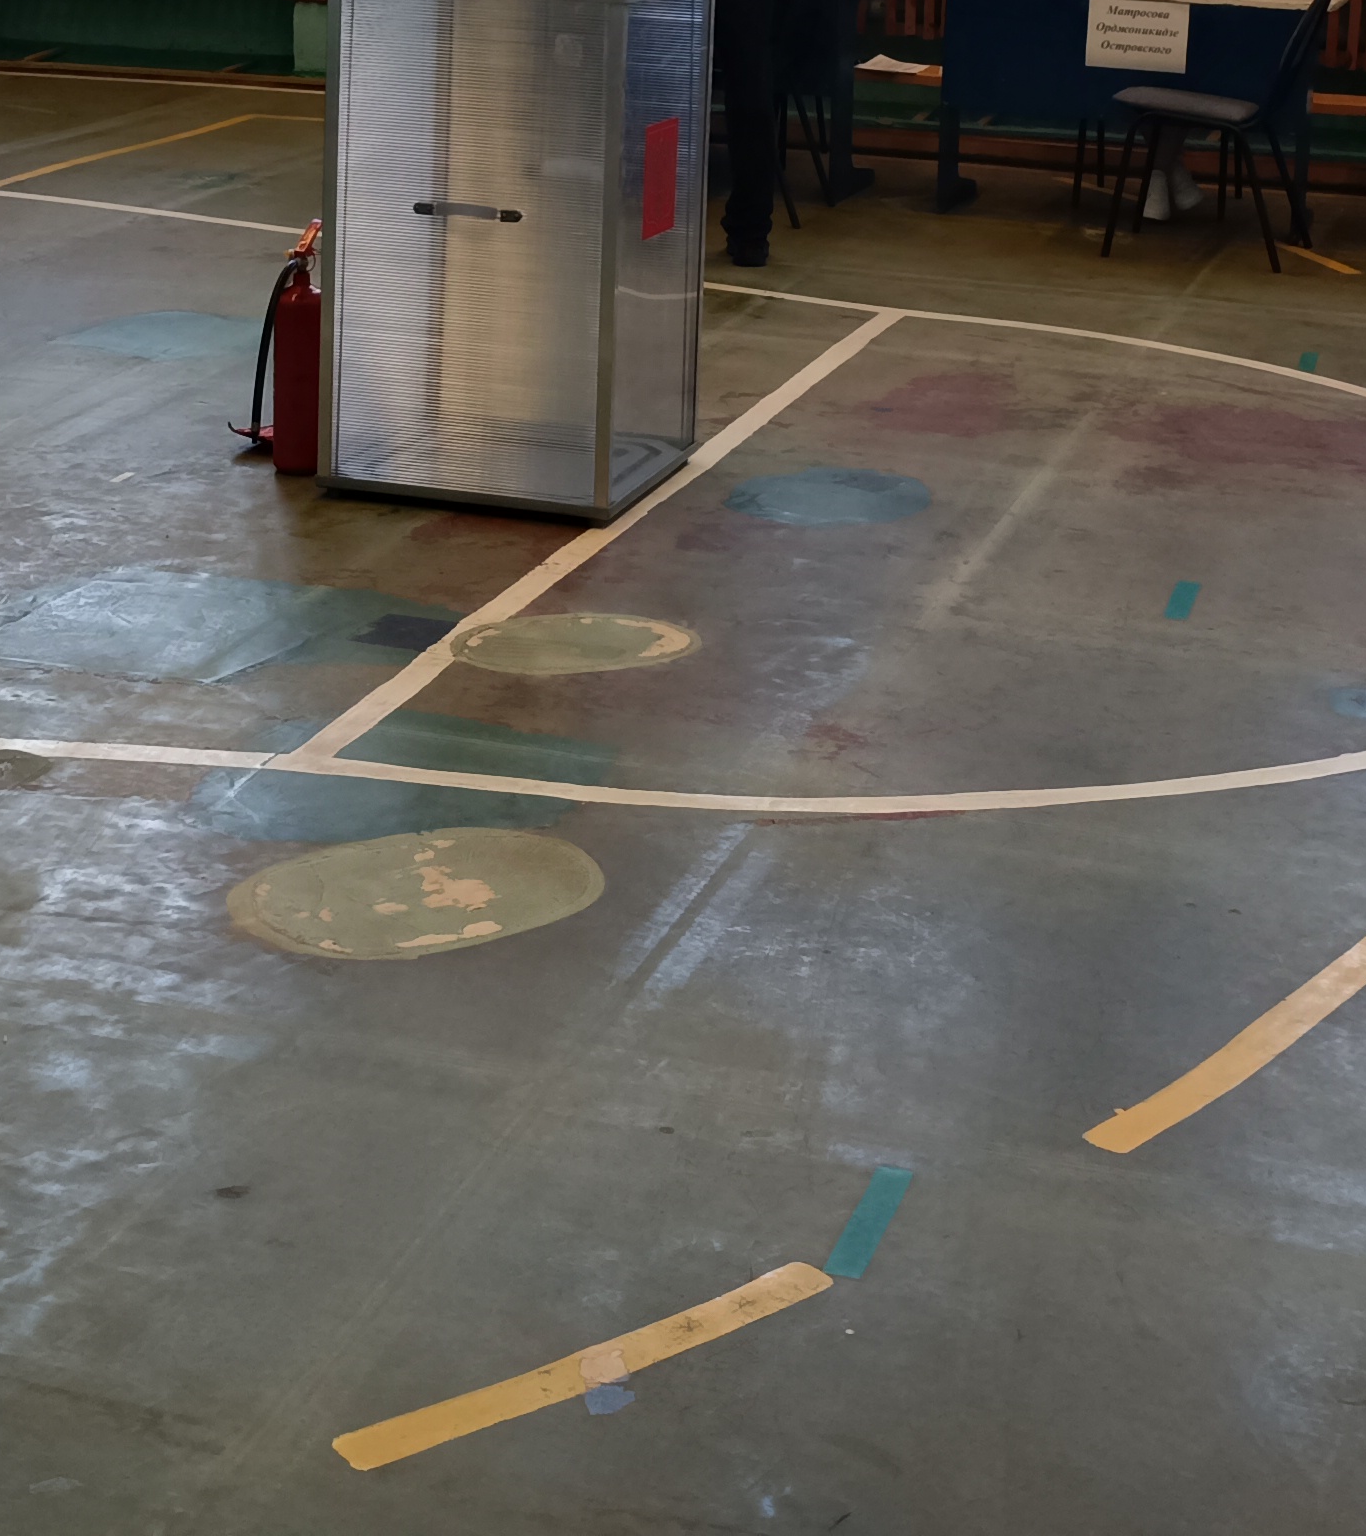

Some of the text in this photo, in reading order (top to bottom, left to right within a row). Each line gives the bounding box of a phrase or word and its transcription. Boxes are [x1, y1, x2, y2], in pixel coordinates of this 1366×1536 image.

[1107, 5, 1170, 19] Матросова
[1095, 22, 1180, 37] Орджоникидзе
[1100, 40, 1172, 55] Островского
